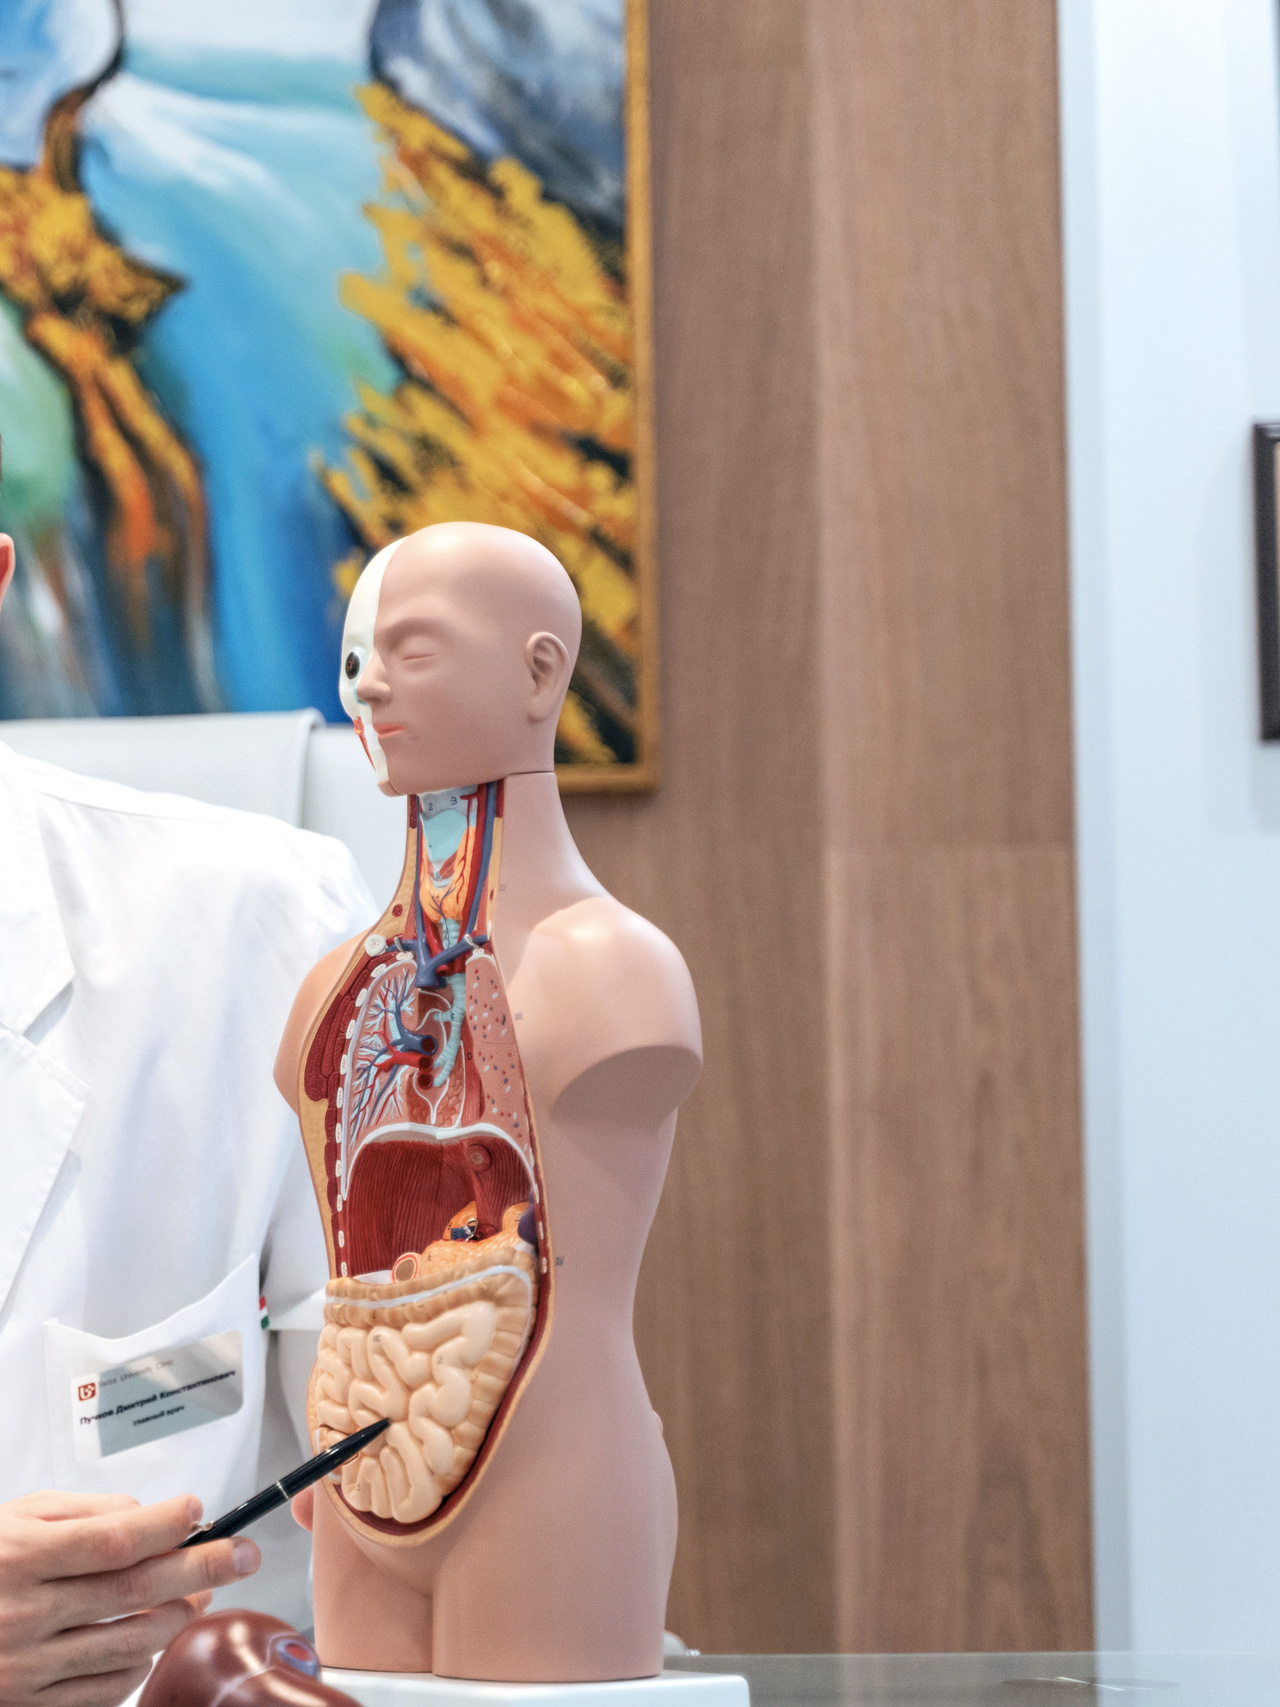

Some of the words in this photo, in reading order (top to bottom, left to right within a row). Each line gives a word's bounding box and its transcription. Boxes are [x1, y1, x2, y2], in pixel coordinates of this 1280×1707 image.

[450, 796, 458, 806] 3
[115, 1394, 157, 1415] Дмитрий
[133, 1410, 165, 1427] главный
[166, 1405, 185, 1417] врач
